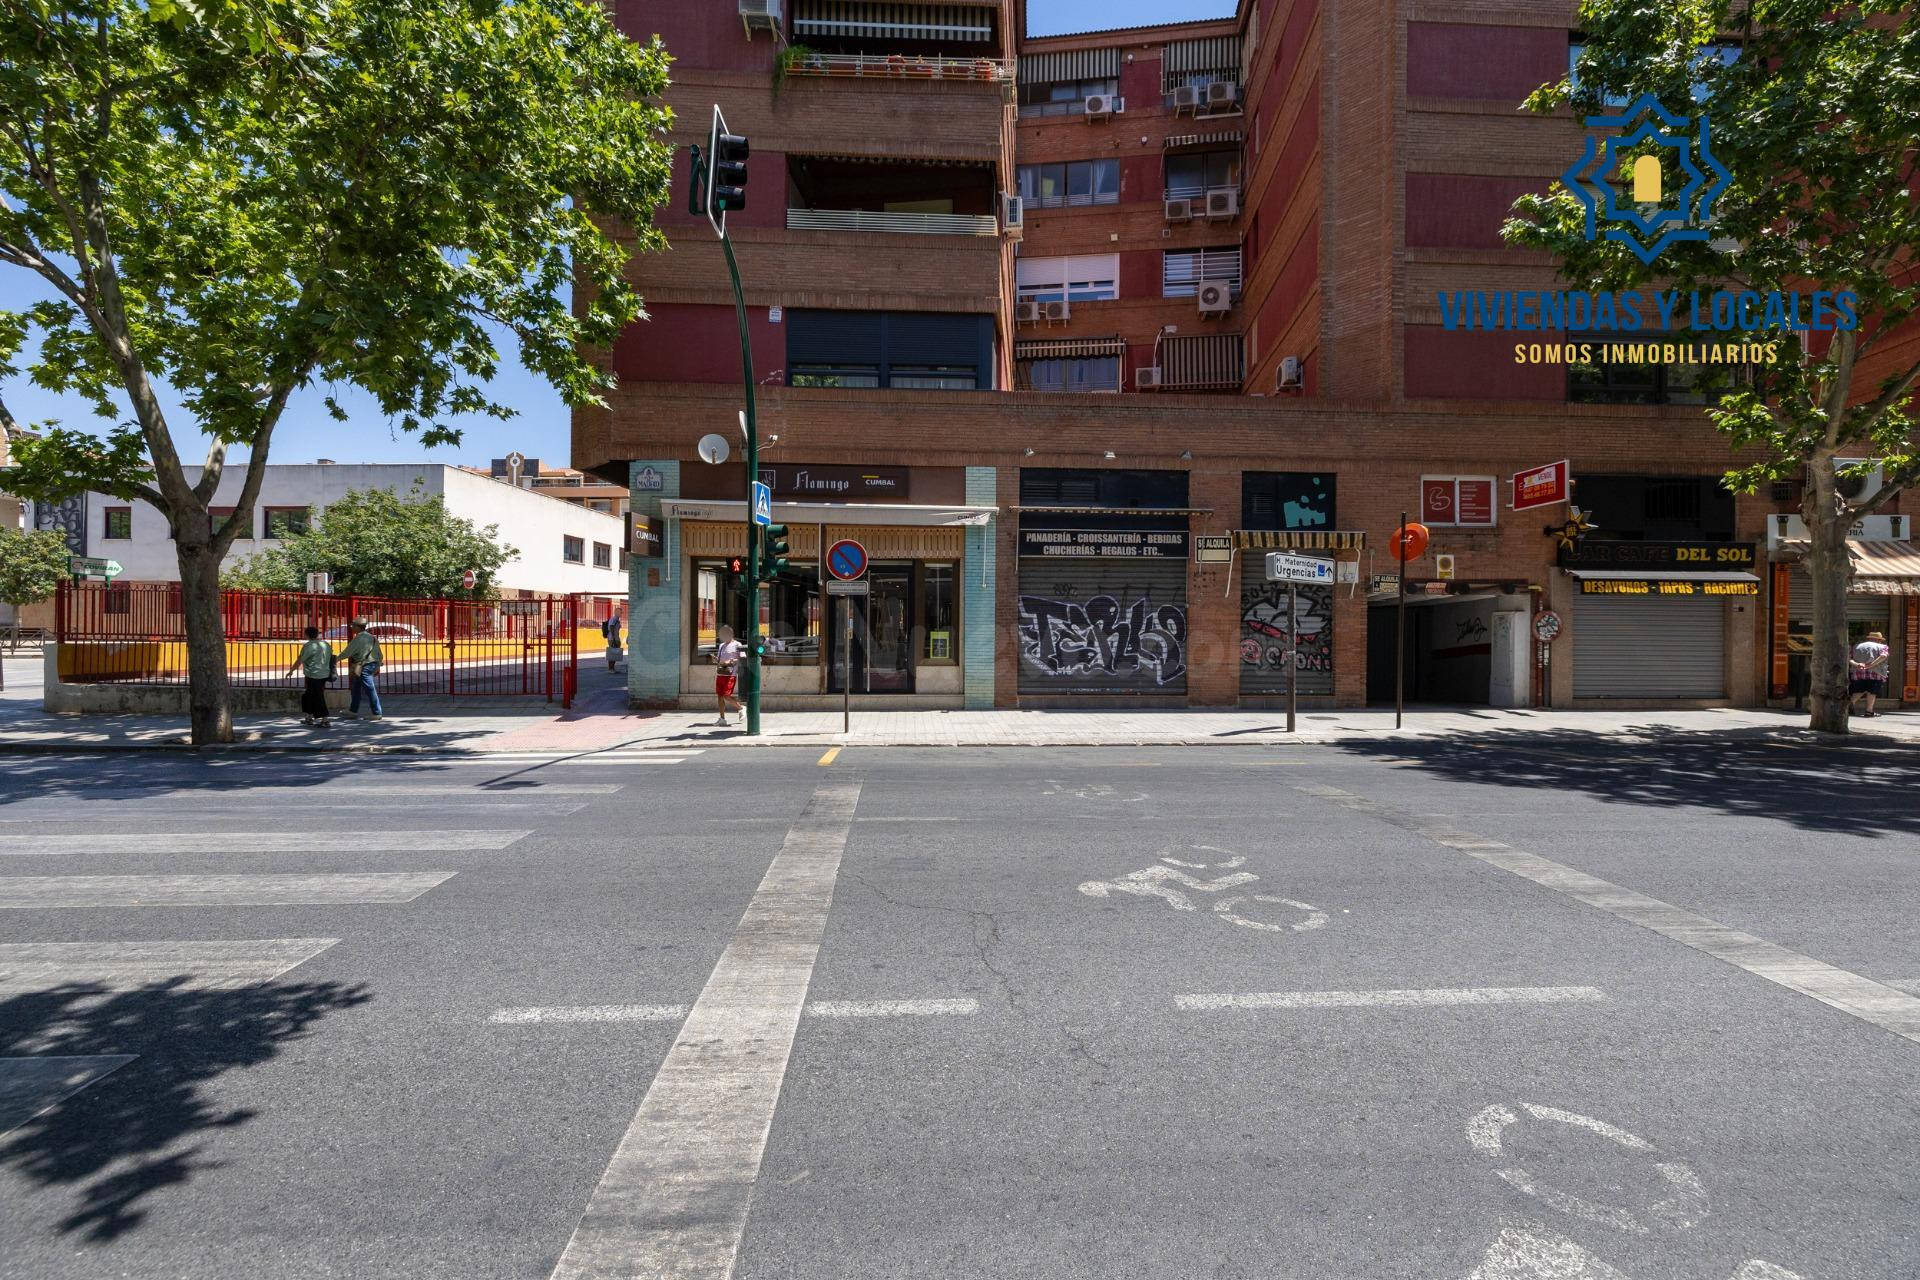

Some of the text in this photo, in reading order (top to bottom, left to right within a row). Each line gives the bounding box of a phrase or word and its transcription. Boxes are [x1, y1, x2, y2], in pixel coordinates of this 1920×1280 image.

[793, 471, 849, 492] Flamingo
[635, 530, 659, 543] CUMBAL
[1026, 532, 1182, 544] PANADERÍA CROISSANTERÍA BEBIDAS
[1043, 544, 1095, 555] CHUCHERÍAS
[1101, 546, 1137, 556] REGALOS
[1206, 539, 1230, 548] ALQUILA
[1676, 548, 1710, 561] DEL
[1717, 548, 1751, 561] SOL
[1285, 558, 1317, 568] Maternidad
[1276, 564, 1316, 578] Urgencias
[1584, 581, 1758, 595] DESAYUNOS TAPAS RACIONES
